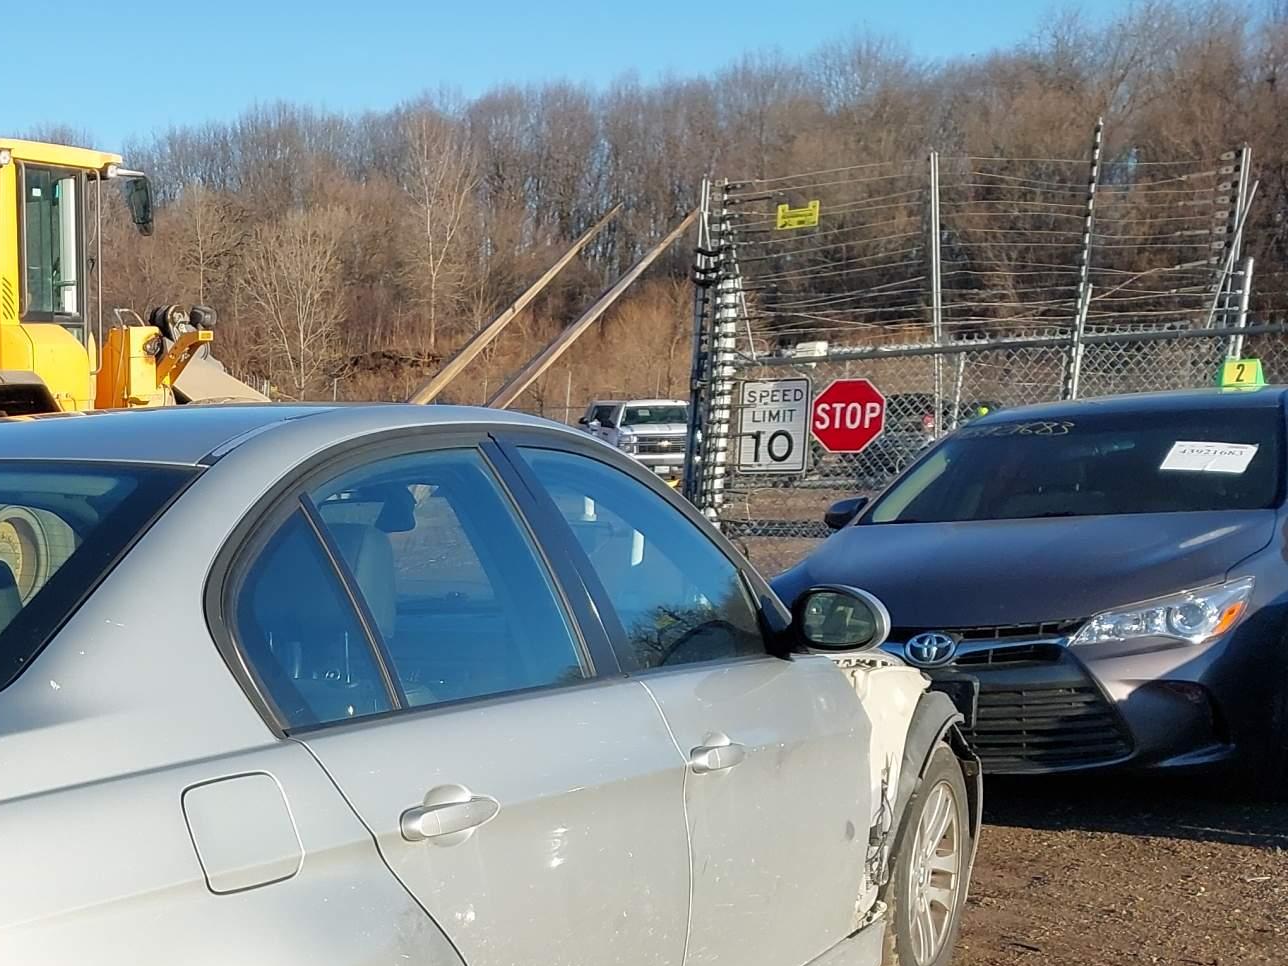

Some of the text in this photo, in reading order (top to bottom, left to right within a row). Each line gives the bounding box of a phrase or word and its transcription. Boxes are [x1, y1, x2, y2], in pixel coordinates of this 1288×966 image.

[1235, 363, 1246, 383] 2
[747, 388, 804, 404] SPEED
[751, 408, 797, 423] LIMIT
[815, 402, 881, 430] STOP
[751, 429, 794, 462] 10
